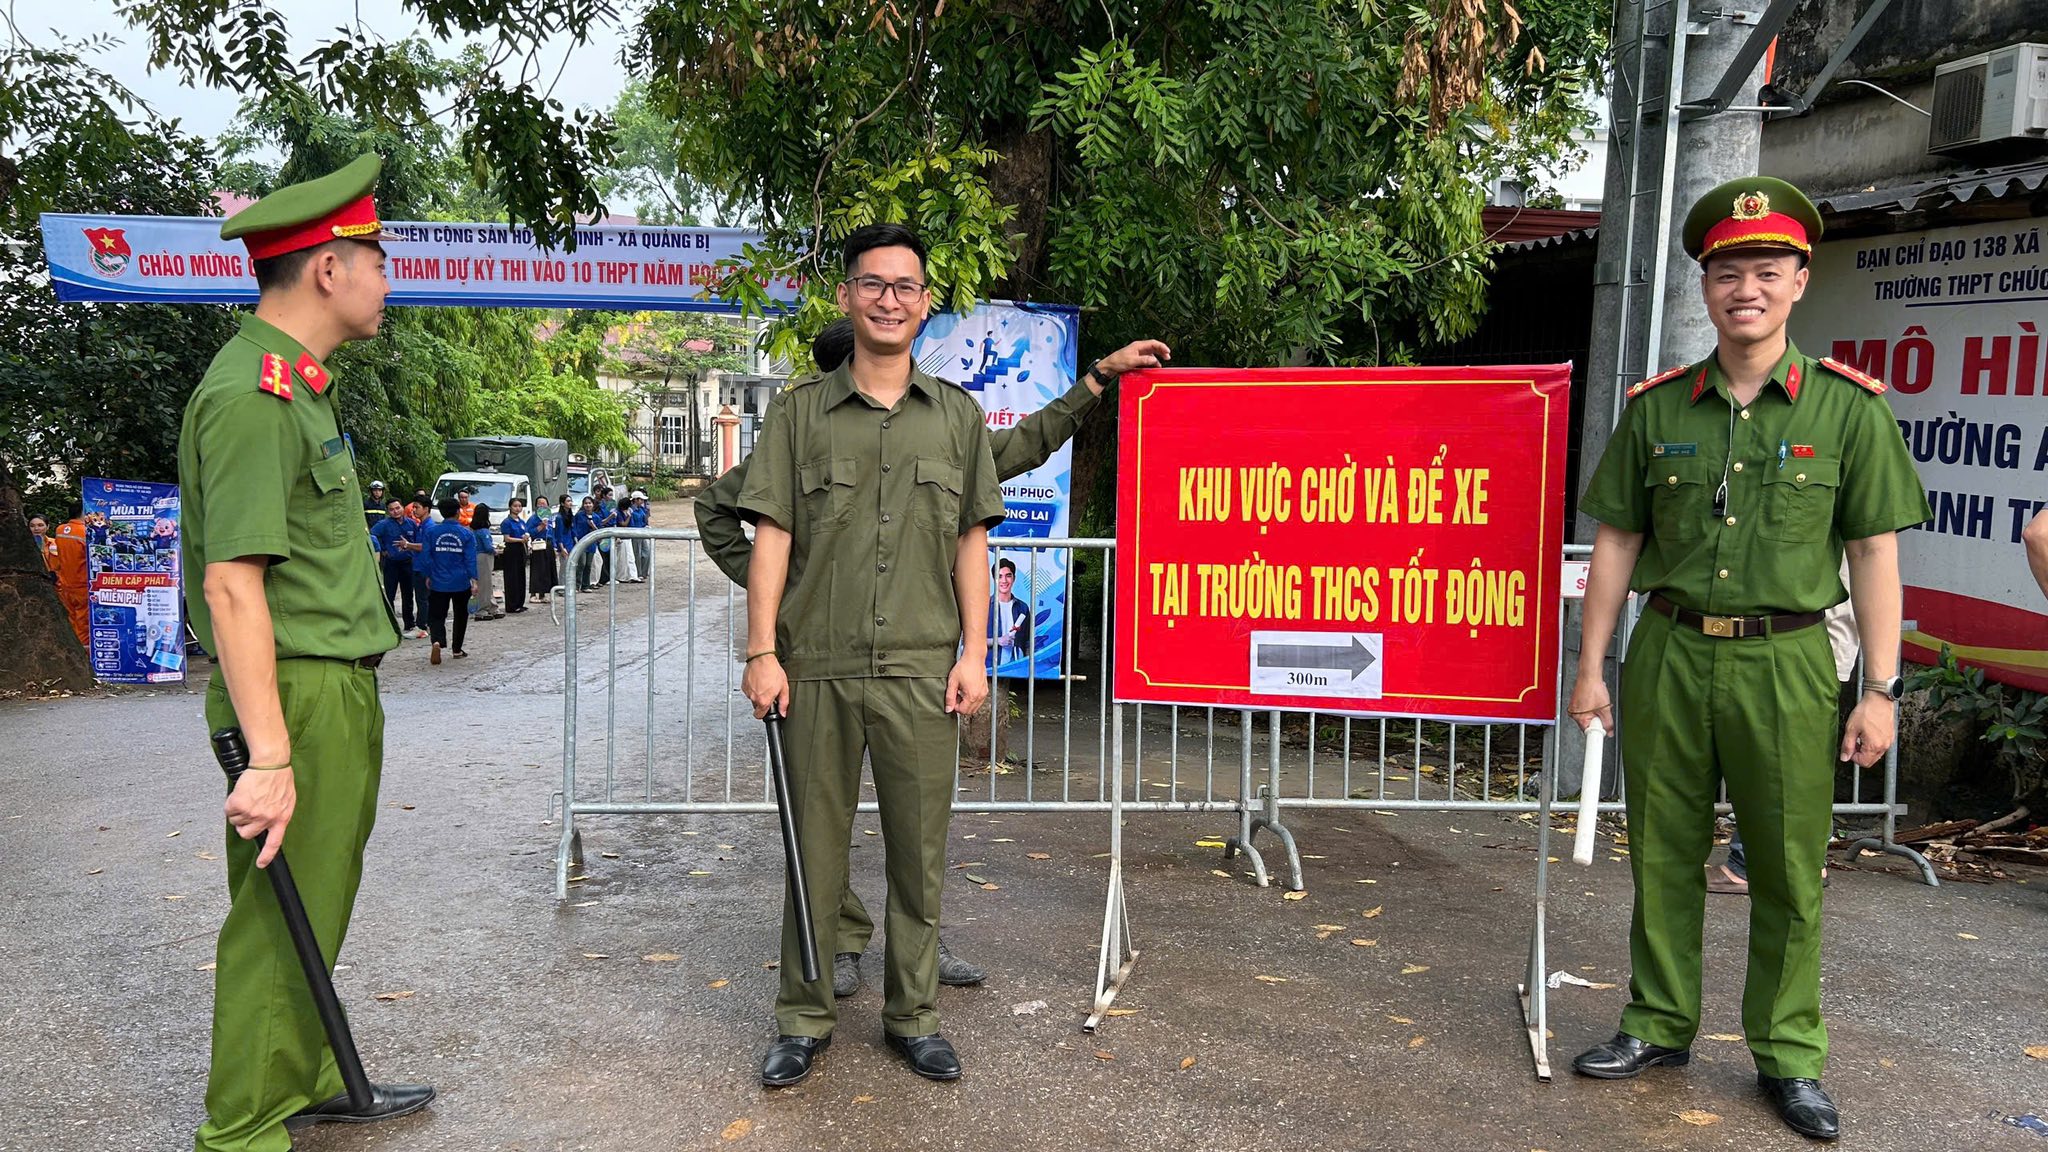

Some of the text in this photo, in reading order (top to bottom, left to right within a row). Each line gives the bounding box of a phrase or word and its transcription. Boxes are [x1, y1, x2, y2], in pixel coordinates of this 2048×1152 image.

[434, 226, 473, 246] CỘNG
[477, 225, 508, 245] SẢN
[617, 230, 638, 247] XÃ
[642, 228, 691, 249] QUẢNG
[696, 233, 710, 253] BỊ
[1895, 237, 1926, 266] CHỈ
[1929, 239, 1967, 266] ĐẠO
[1972, 236, 2008, 259] 138
[2012, 227, 2041, 256] XÃ
[138, 250, 186, 277] CHÀO
[189, 250, 243, 277] MỪNG
[392, 257, 441, 281] THAM
[446, 256, 471, 286] DỰ
[474, 255, 496, 282] KỲ
[500, 259, 527, 282] THI
[532, 255, 566, 283] VÀO
[572, 261, 593, 283] 10
[597, 261, 639, 285] THPT
[644, 259, 684, 286] NĂM
[1875, 274, 1942, 300] TRƯỜNG
[1948, 273, 1994, 296] THPT
[1831, 325, 1935, 395] MÔ
[1020, 487, 1055, 501] PHỤC
[1178, 443, 1490, 535] KHU VỰC CHỜ VÀ ĐỂ XE
[110, 504, 154, 515] MÙA THI
[1031, 509, 1049, 521] LAI
[1149, 548, 1525, 638] TẠI TRƯỜNG THCS TỐT ĐỘNG
[1286, 672, 1328, 686] 300m
